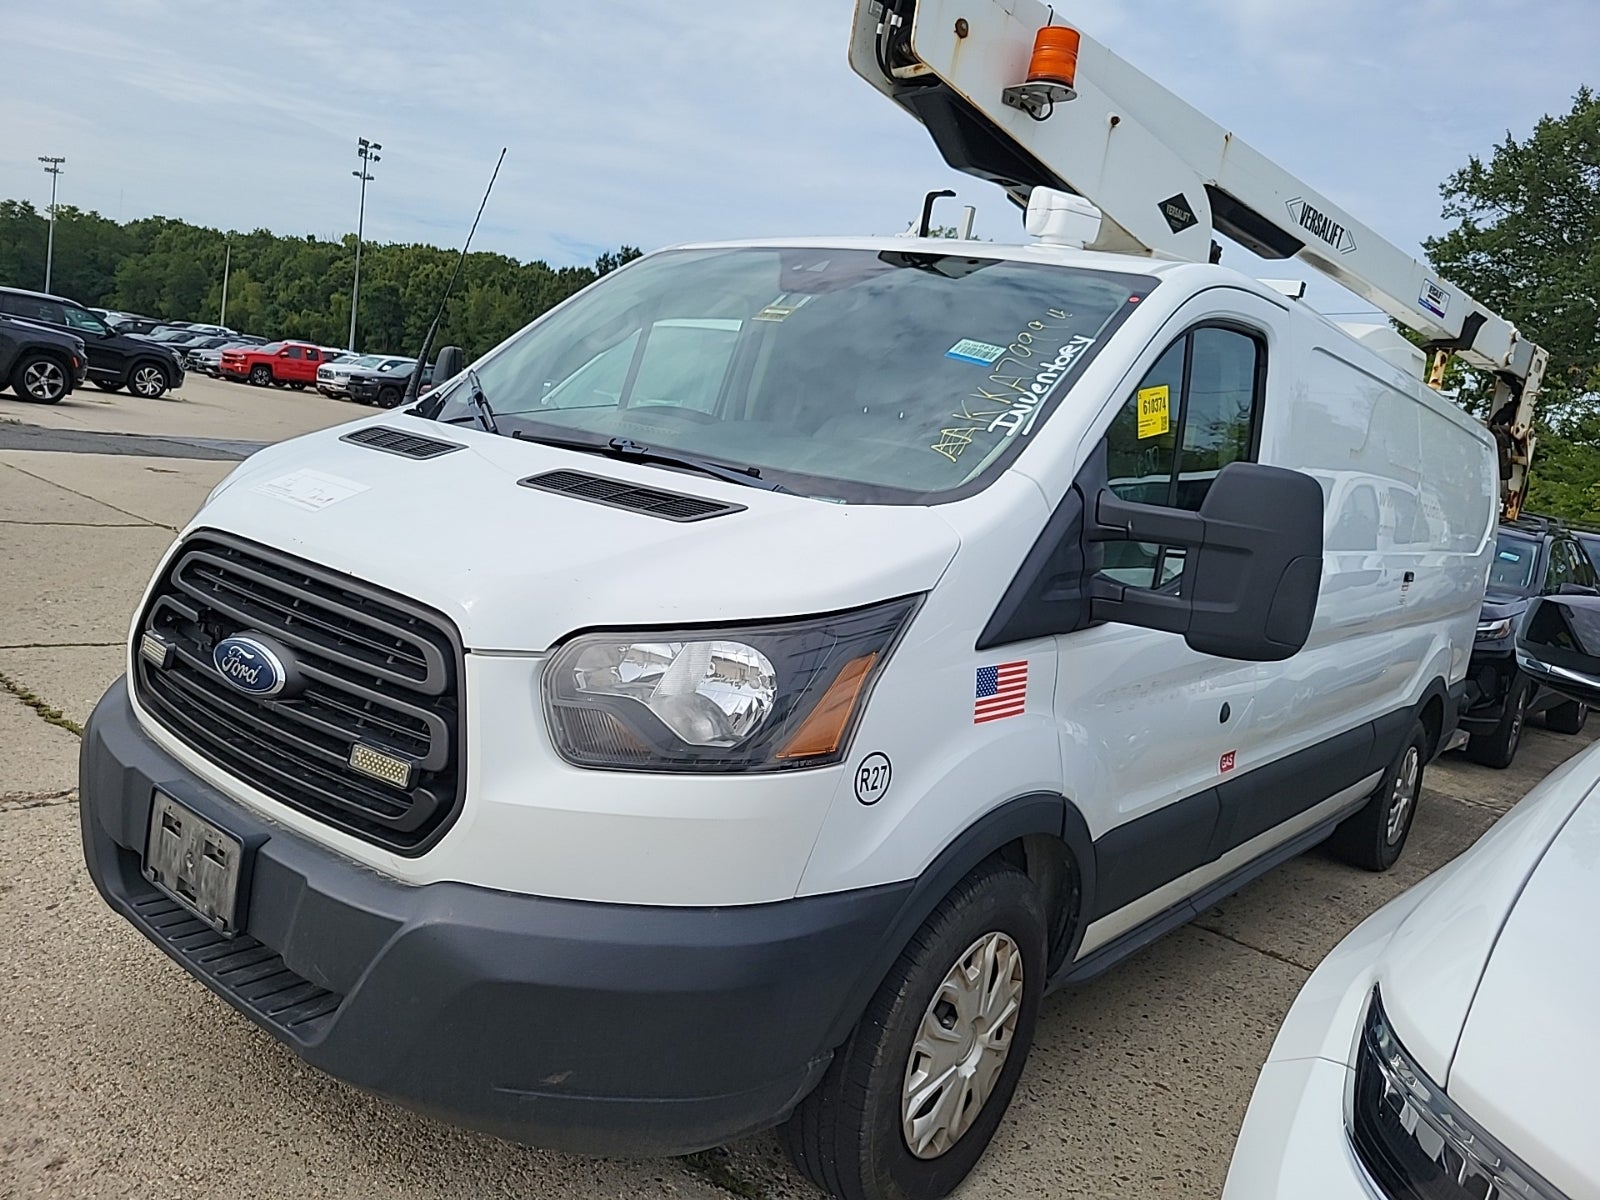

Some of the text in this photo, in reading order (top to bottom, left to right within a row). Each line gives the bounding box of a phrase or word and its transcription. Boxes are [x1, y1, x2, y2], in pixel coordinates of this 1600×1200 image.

[1299, 202, 1345, 249] VERSALIFT
[1143, 396, 1167, 415] 610374
[222, 645, 263, 685] Ford
[860, 765, 888, 793] R27
